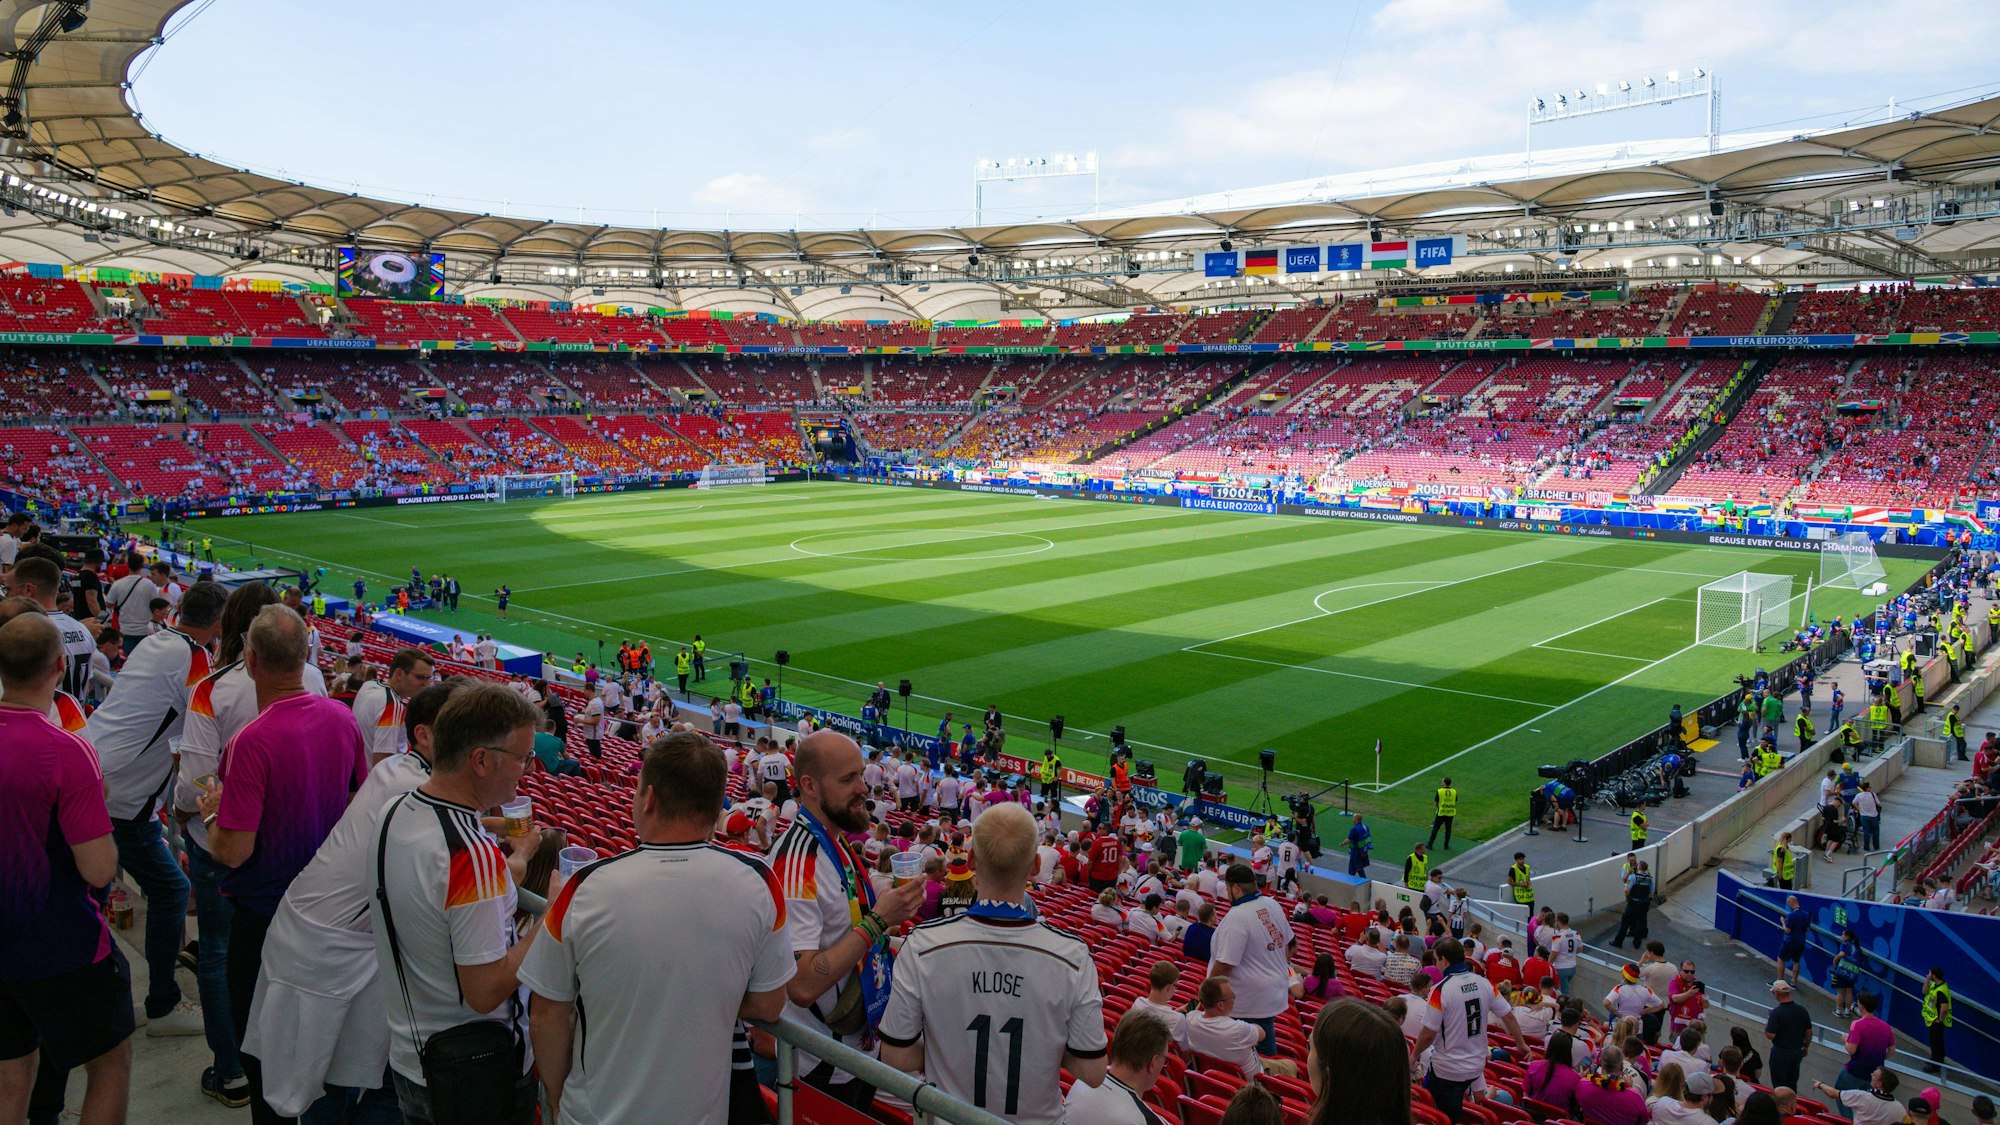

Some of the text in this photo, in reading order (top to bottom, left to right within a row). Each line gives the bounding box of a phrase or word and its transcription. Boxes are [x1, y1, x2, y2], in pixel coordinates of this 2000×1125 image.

[1420, 246, 1447, 259] FIFA
[1289, 255, 1317, 266] UEFA
[0, 333, 72, 343] TUTTGART
[555, 343, 594, 351] STUTTGA
[1435, 341, 1497, 349] STUTTGART
[1216, 487, 1246, 498] 1900
[1416, 484, 1459, 496] ROGATZ
[1527, 489, 1585, 501] BRACHELEN
[397, 497, 422, 505] BECAUSE
[423, 495, 440, 503] EVERY
[441, 494, 458, 502] CHILD
[1109, 494, 1148, 503] FOUNDATION
[222, 503, 322, 516] UEFA FOUNDATION for children
[1305, 508, 1330, 516] BECAUSE
[1331, 510, 1349, 518] EVERY
[1350, 511, 1369, 519] CHILD
[1382, 514, 1417, 522] CHAMPION
[1499, 521, 1612, 537] UEFA FOUNDATION for children
[1709, 535, 1873, 553] BECAUSE EVERY CHILD IS A CHAMPION
[384, 617, 444, 635] HUNGARY
[63, 630, 85, 644] USIALA
[826, 712, 882, 737] Booking.
[767, 765, 779, 777] 10
[1077, 776, 1105, 788] BETANO
[1101, 847, 1118, 863] 10
[1284, 850, 1291, 862] 8
[1568, 939, 1574, 953] 9
[972, 971, 1024, 998] KLOSE
[1461, 984, 1479, 994] KROOS
[1464, 998, 1481, 1038] 8
[966, 1014, 1024, 1116] 11
